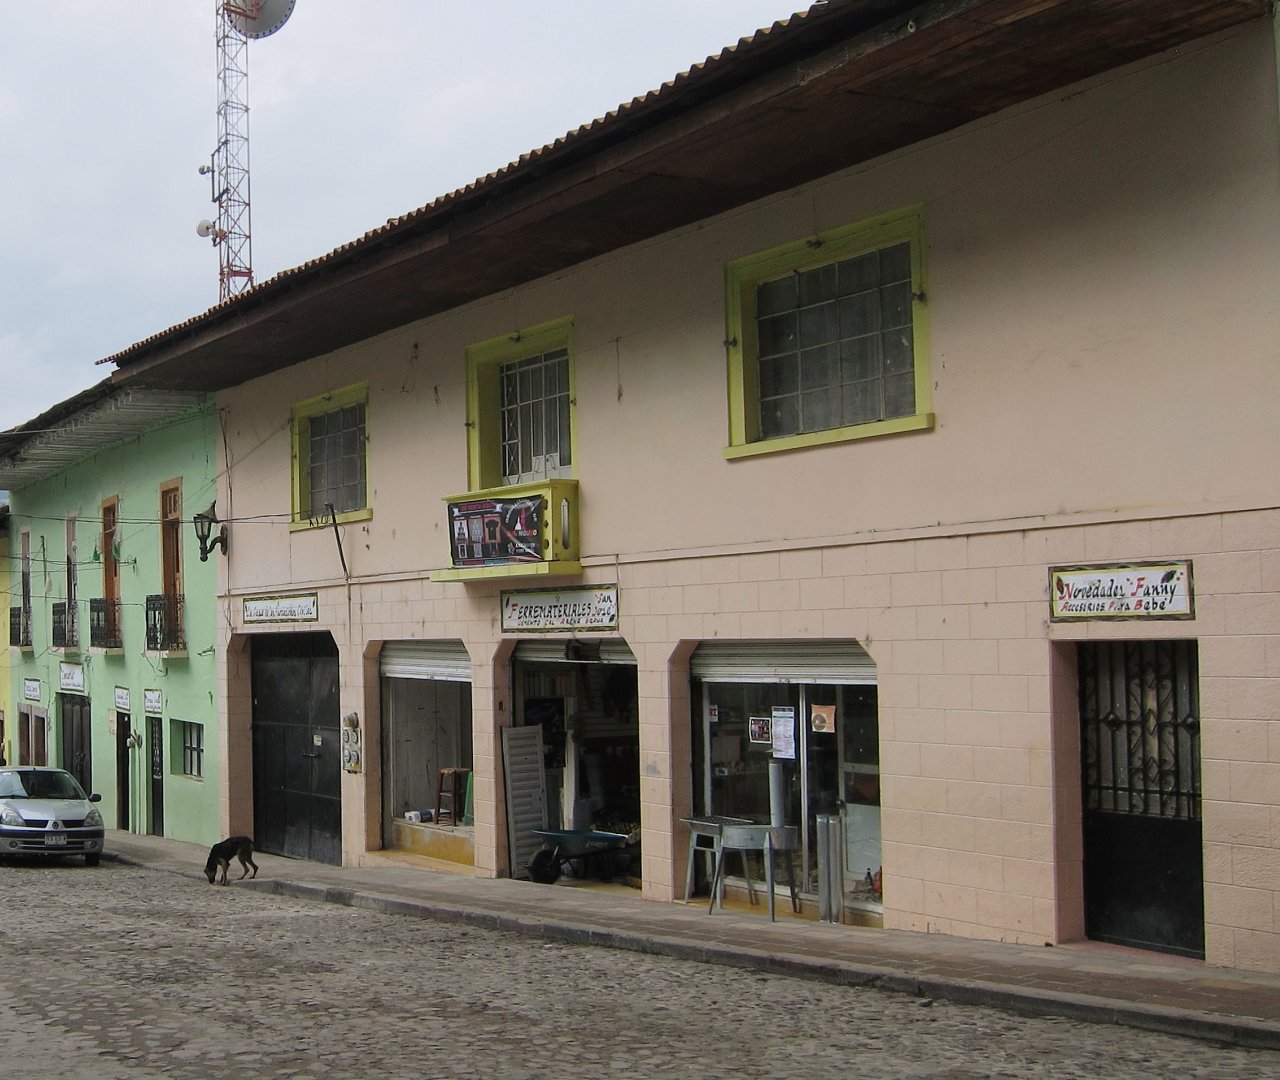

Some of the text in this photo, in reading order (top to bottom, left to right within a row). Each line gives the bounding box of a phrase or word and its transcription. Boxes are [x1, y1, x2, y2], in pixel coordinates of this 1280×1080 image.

[1059, 578, 1125, 600] Novedades
[508, 603, 591, 620] FERREMATERIALES
[1134, 598, 1168, 611] Bebé
